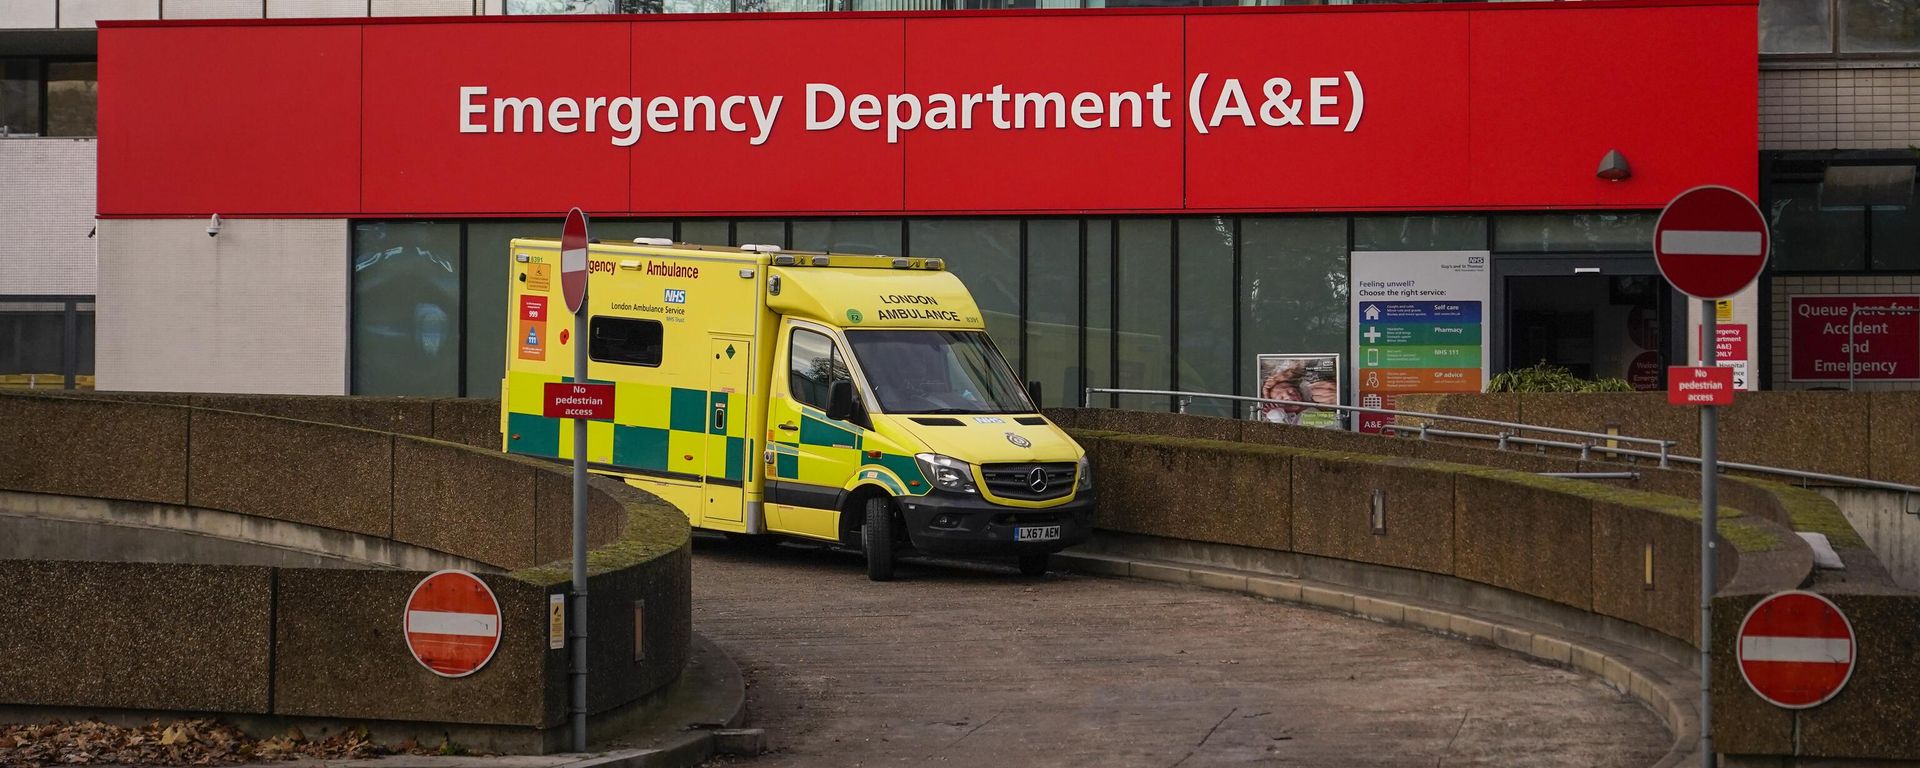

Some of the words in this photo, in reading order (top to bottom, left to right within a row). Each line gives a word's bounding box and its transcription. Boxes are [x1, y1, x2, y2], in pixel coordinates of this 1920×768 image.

[459, 86, 783, 147] Emergency
[805, 79, 1172, 144] Department
[1188, 70, 1365, 134] (A&E)
[588, 259, 616, 275] gency
[646, 260, 699, 279] Ambulance
[664, 289, 685, 303] NHS
[1359, 289, 1386, 297] Choose
[1400, 289, 1418, 297] right
[880, 295, 938, 305] LONDON
[611, 302, 632, 311] London
[633, 304, 664, 313] Ambulance
[665, 306, 685, 315] Service
[1799, 303, 1848, 318] Queue
[1890, 302, 1913, 316] for
[529, 310, 538, 318] 999
[878, 310, 961, 322] AMBULANCE
[1434, 326, 1463, 334] Pharmacy
[1823, 321, 1889, 335] Accdent
[1695, 369, 1707, 378] No
[573, 385, 586, 394] No
[1679, 381, 1723, 391] pedestrian
[555, 396, 603, 406] pedestrian
[565, 408, 593, 416] access
[1364, 420, 1382, 429] A&E
[1021, 528, 1043, 539] LX67
